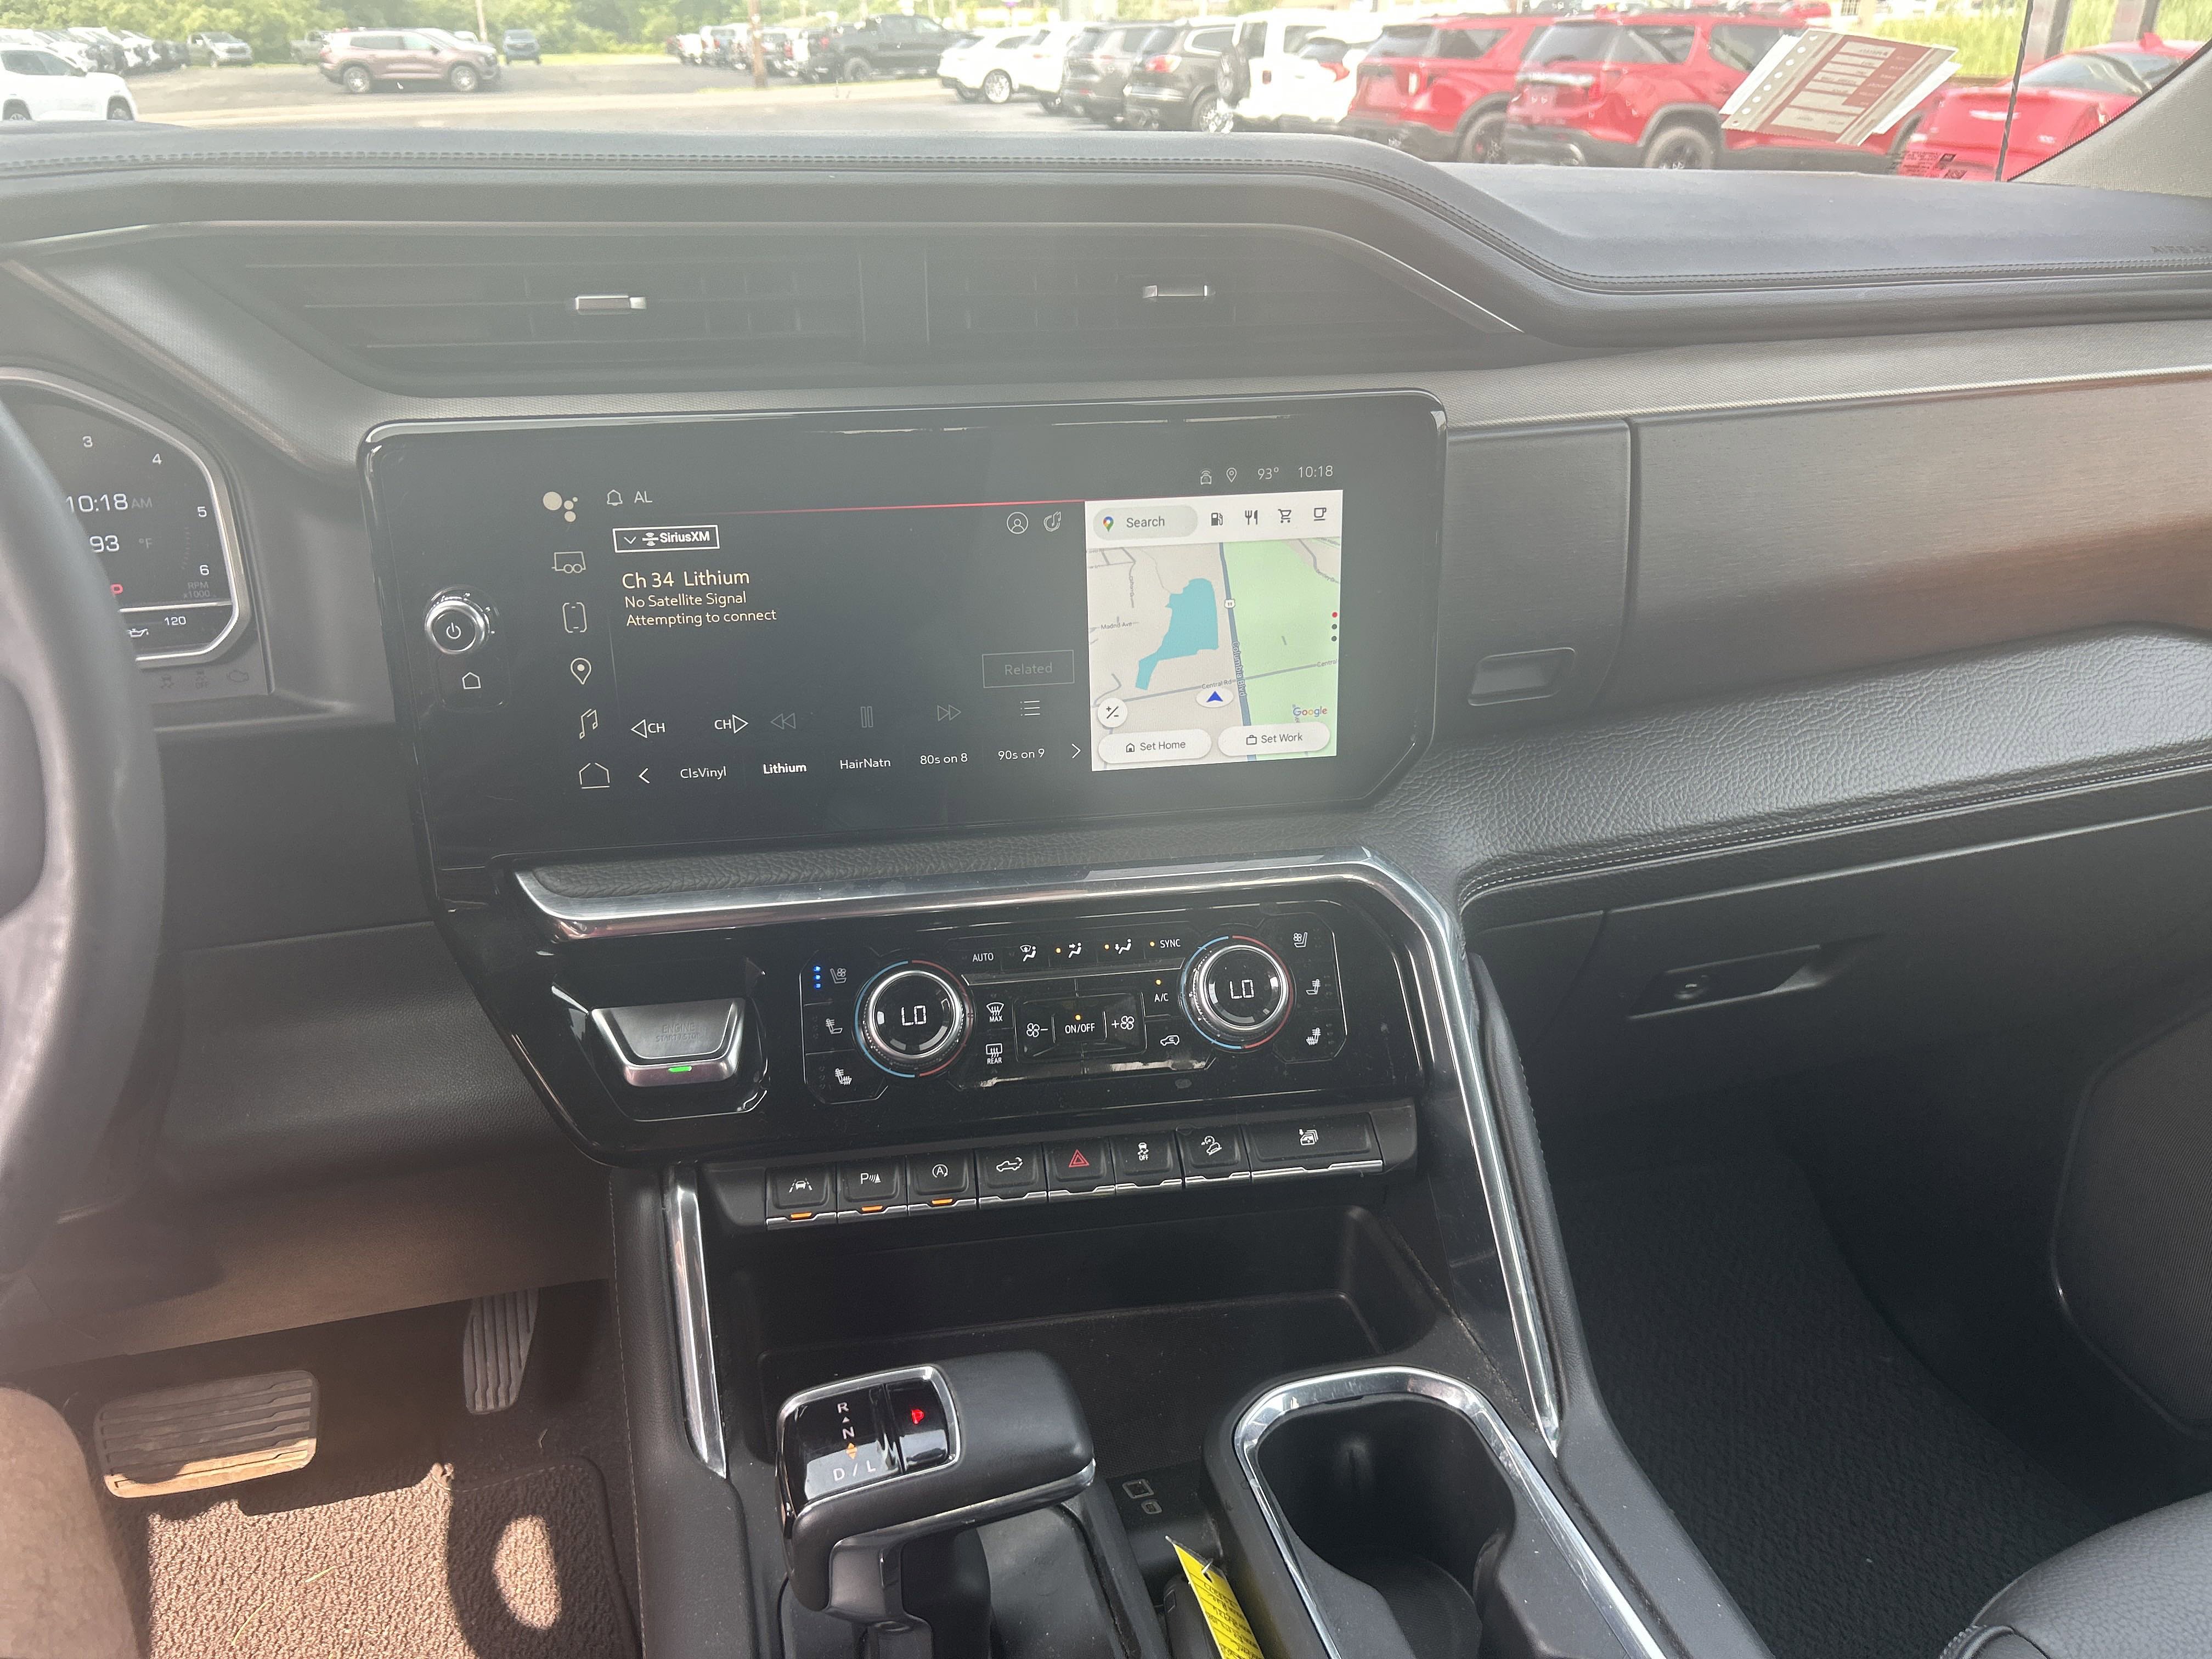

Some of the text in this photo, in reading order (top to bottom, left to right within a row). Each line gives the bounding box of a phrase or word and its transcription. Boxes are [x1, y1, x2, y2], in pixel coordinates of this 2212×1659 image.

[82, 436, 93, 448] 3
[153, 453, 162, 465] 4
[1257, 467, 1279, 479] 93°
[1298, 465, 1333, 478] 10:18
[66, 493, 153, 513] 10:18 AM
[634, 491, 652, 503] AL
[198, 506, 207, 517] 5
[1126, 516, 1165, 529] Search
[659, 531, 710, 544] SiriusXM
[89, 535, 120, 553] 93
[199, 565, 210, 575] 6
[622, 569, 750, 589] Ch 34 Lithium
[625, 591, 747, 608] No Satellite Signal
[165, 616, 187, 626] 120
[627, 609, 777, 627] Attempting to connect
[1005, 662, 1052, 676] Related
[1232, 641, 1247, 697] Columbia Blvd
[1317, 659, 1338, 668] Central
[1201, 680, 1223, 690] Central
[1293, 706, 1328, 718] Google
[648, 723, 666, 733] CH
[714, 719, 731, 730] CH
[1261, 732, 1303, 743] Set Work
[1158, 740, 1186, 749] Home
[920, 752, 968, 765] 80s on 8
[998, 748, 1045, 761] 90s on 9
[763, 763, 807, 775] Lithium
[840, 757, 891, 770] HairNatn
[1160, 939, 1181, 949] SYNC
[972, 952, 994, 962] AUTO
[1154, 992, 1169, 1003] A/C
[1065, 1023, 1095, 1034] ON/OFF
[837, 1402, 849, 1414] R
[911, 1409, 925, 1425] P
[842, 1426, 855, 1440] N
